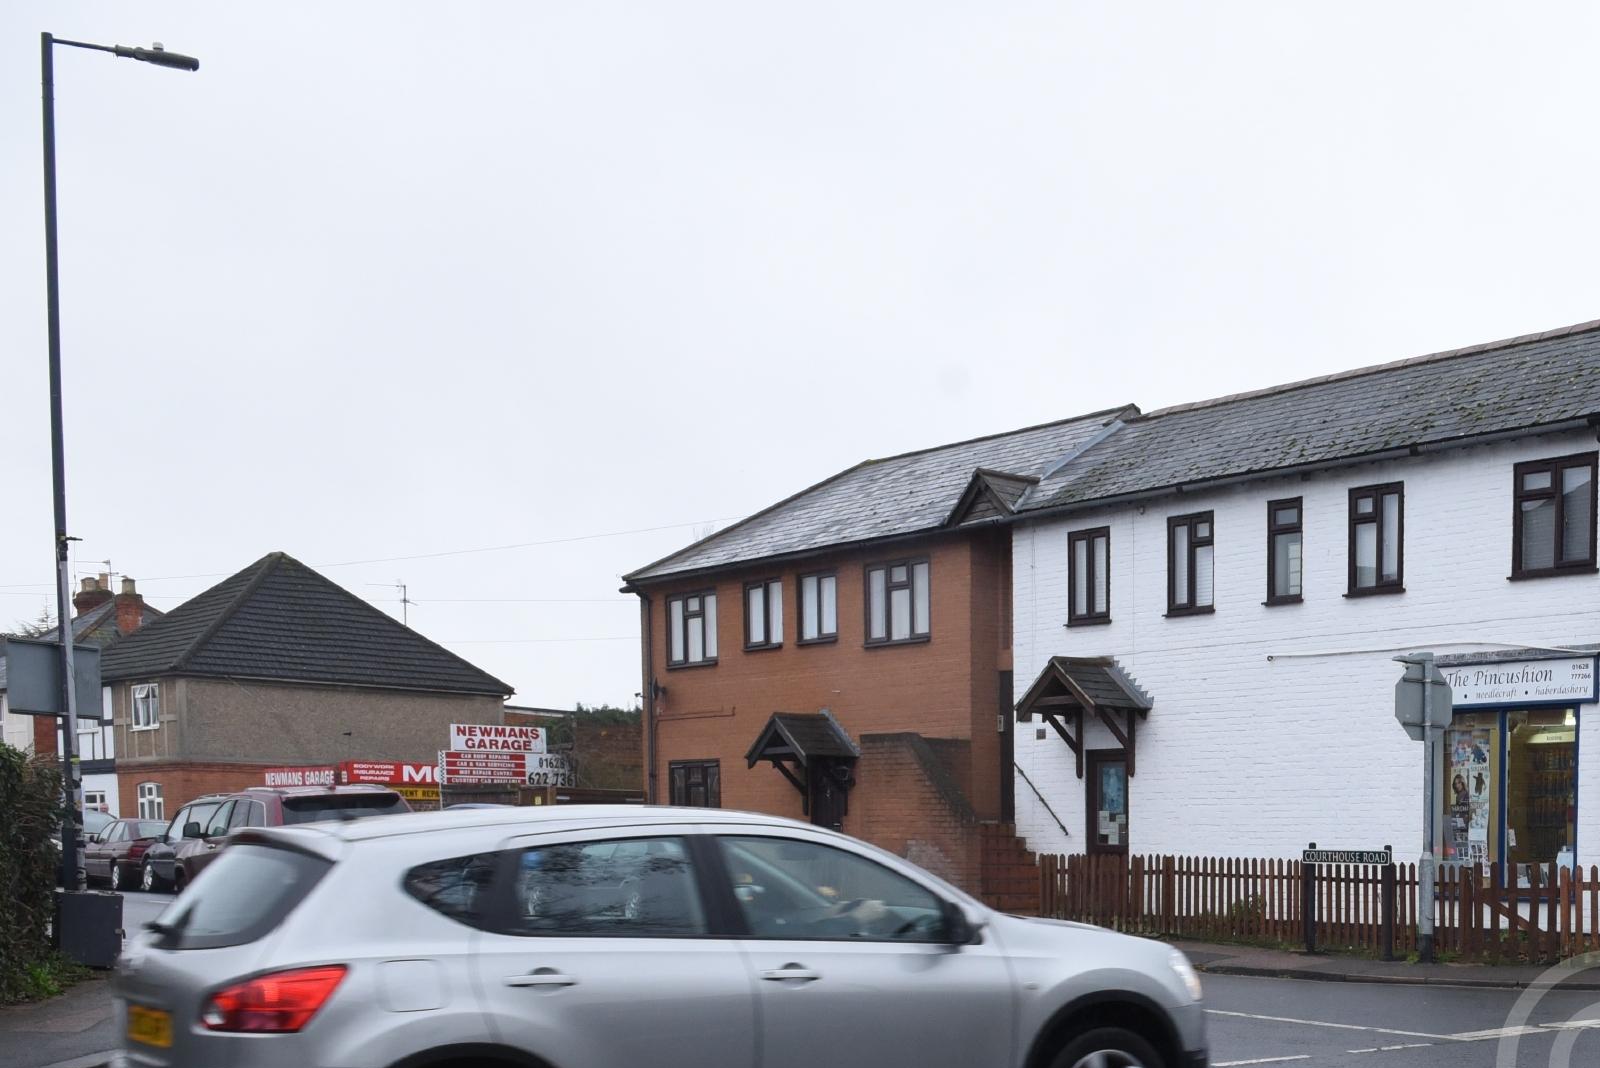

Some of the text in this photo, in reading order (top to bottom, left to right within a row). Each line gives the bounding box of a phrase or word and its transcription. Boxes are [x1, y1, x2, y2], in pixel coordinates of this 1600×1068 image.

[1445, 665, 1553, 688] The Pincushion
[1476, 684, 1589, 699] needlecraft haberdashery
[456, 725, 540, 740] NEWMANS
[465, 739, 532, 751] GARAGE
[265, 772, 303, 786] NEWMANS
[305, 770, 334, 785] GARAGE
[528, 772, 548, 785] 622
[1304, 851, 1386, 863] COURTHOUSE ROAD
